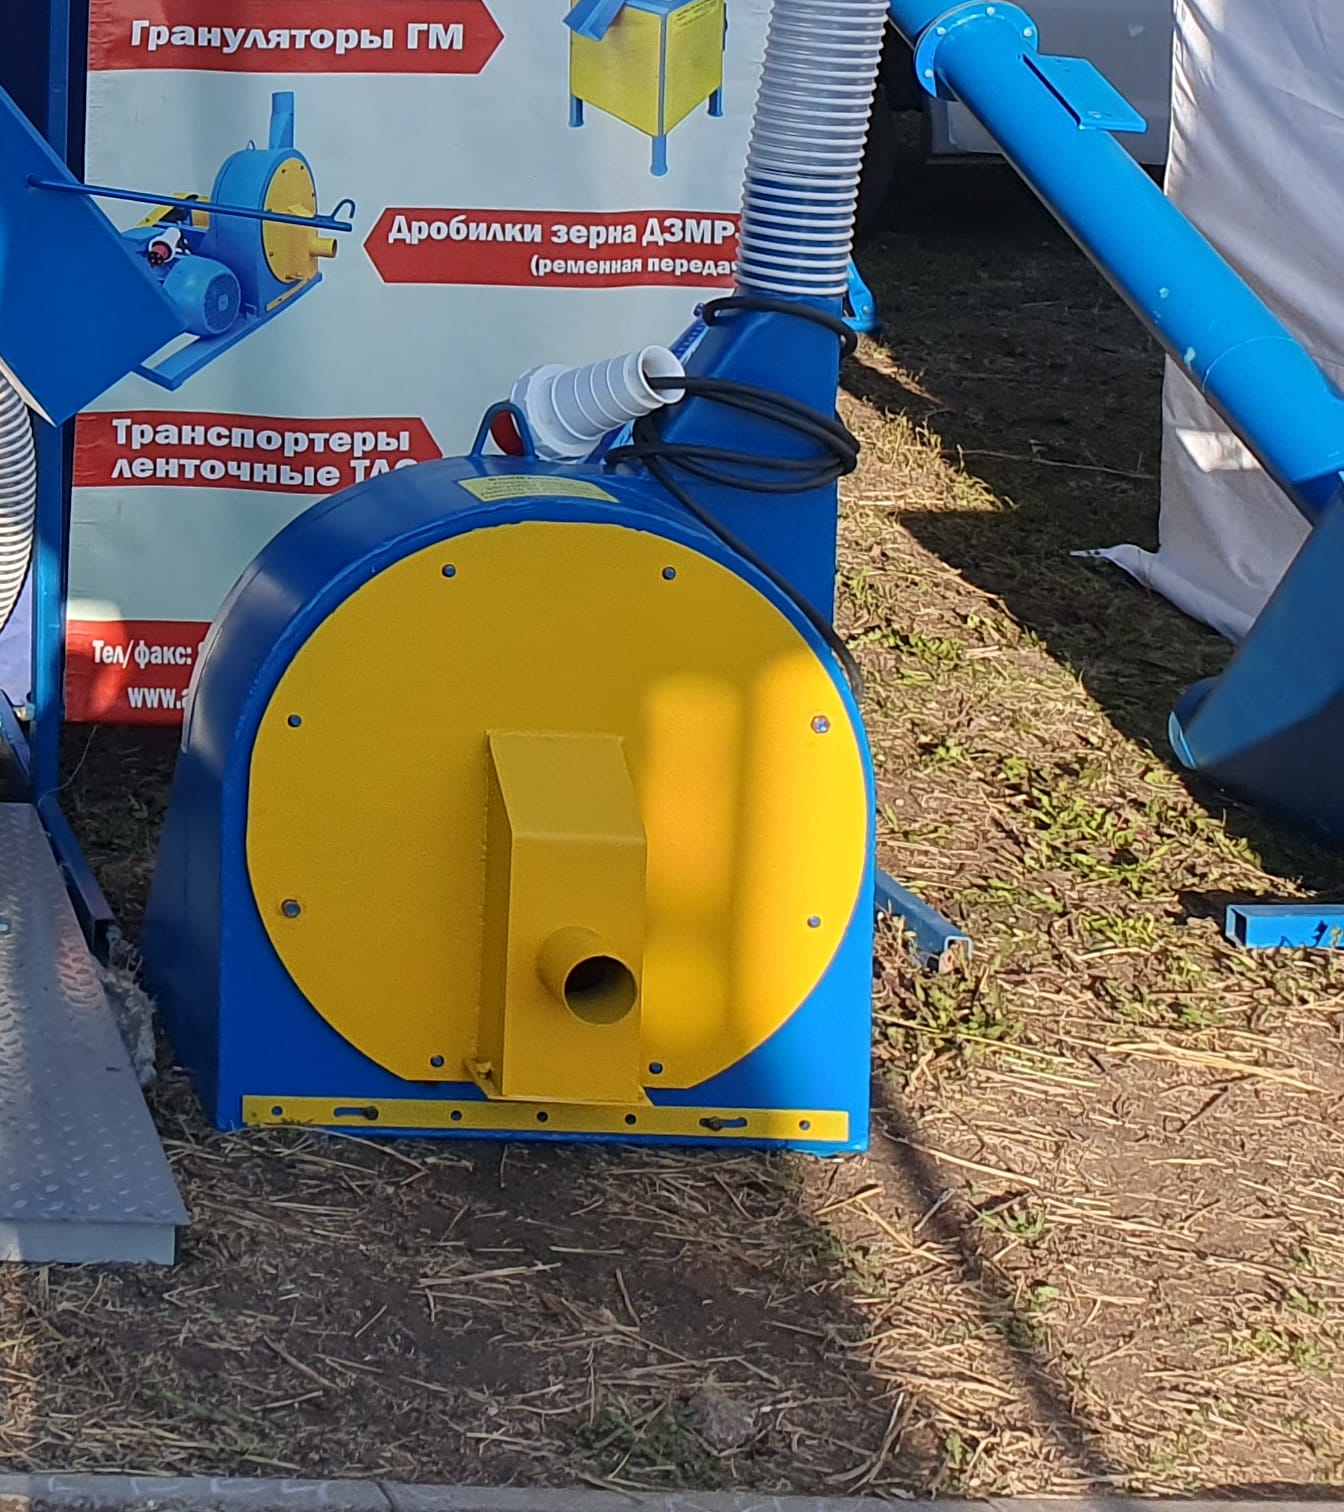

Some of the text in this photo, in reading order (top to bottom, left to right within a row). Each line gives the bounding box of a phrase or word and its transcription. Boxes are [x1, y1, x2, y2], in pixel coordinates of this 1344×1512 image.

[130, 20, 464, 55] Грануляторы ГМ
[388, 215, 542, 243] Дробилки
[551, 224, 637, 250] зерна
[530, 254, 643, 276] (ременная
[112, 418, 409, 456] Транспортеры
[111, 457, 340, 486] ленточные
[92, 640, 192, 669] Тел/факс:
